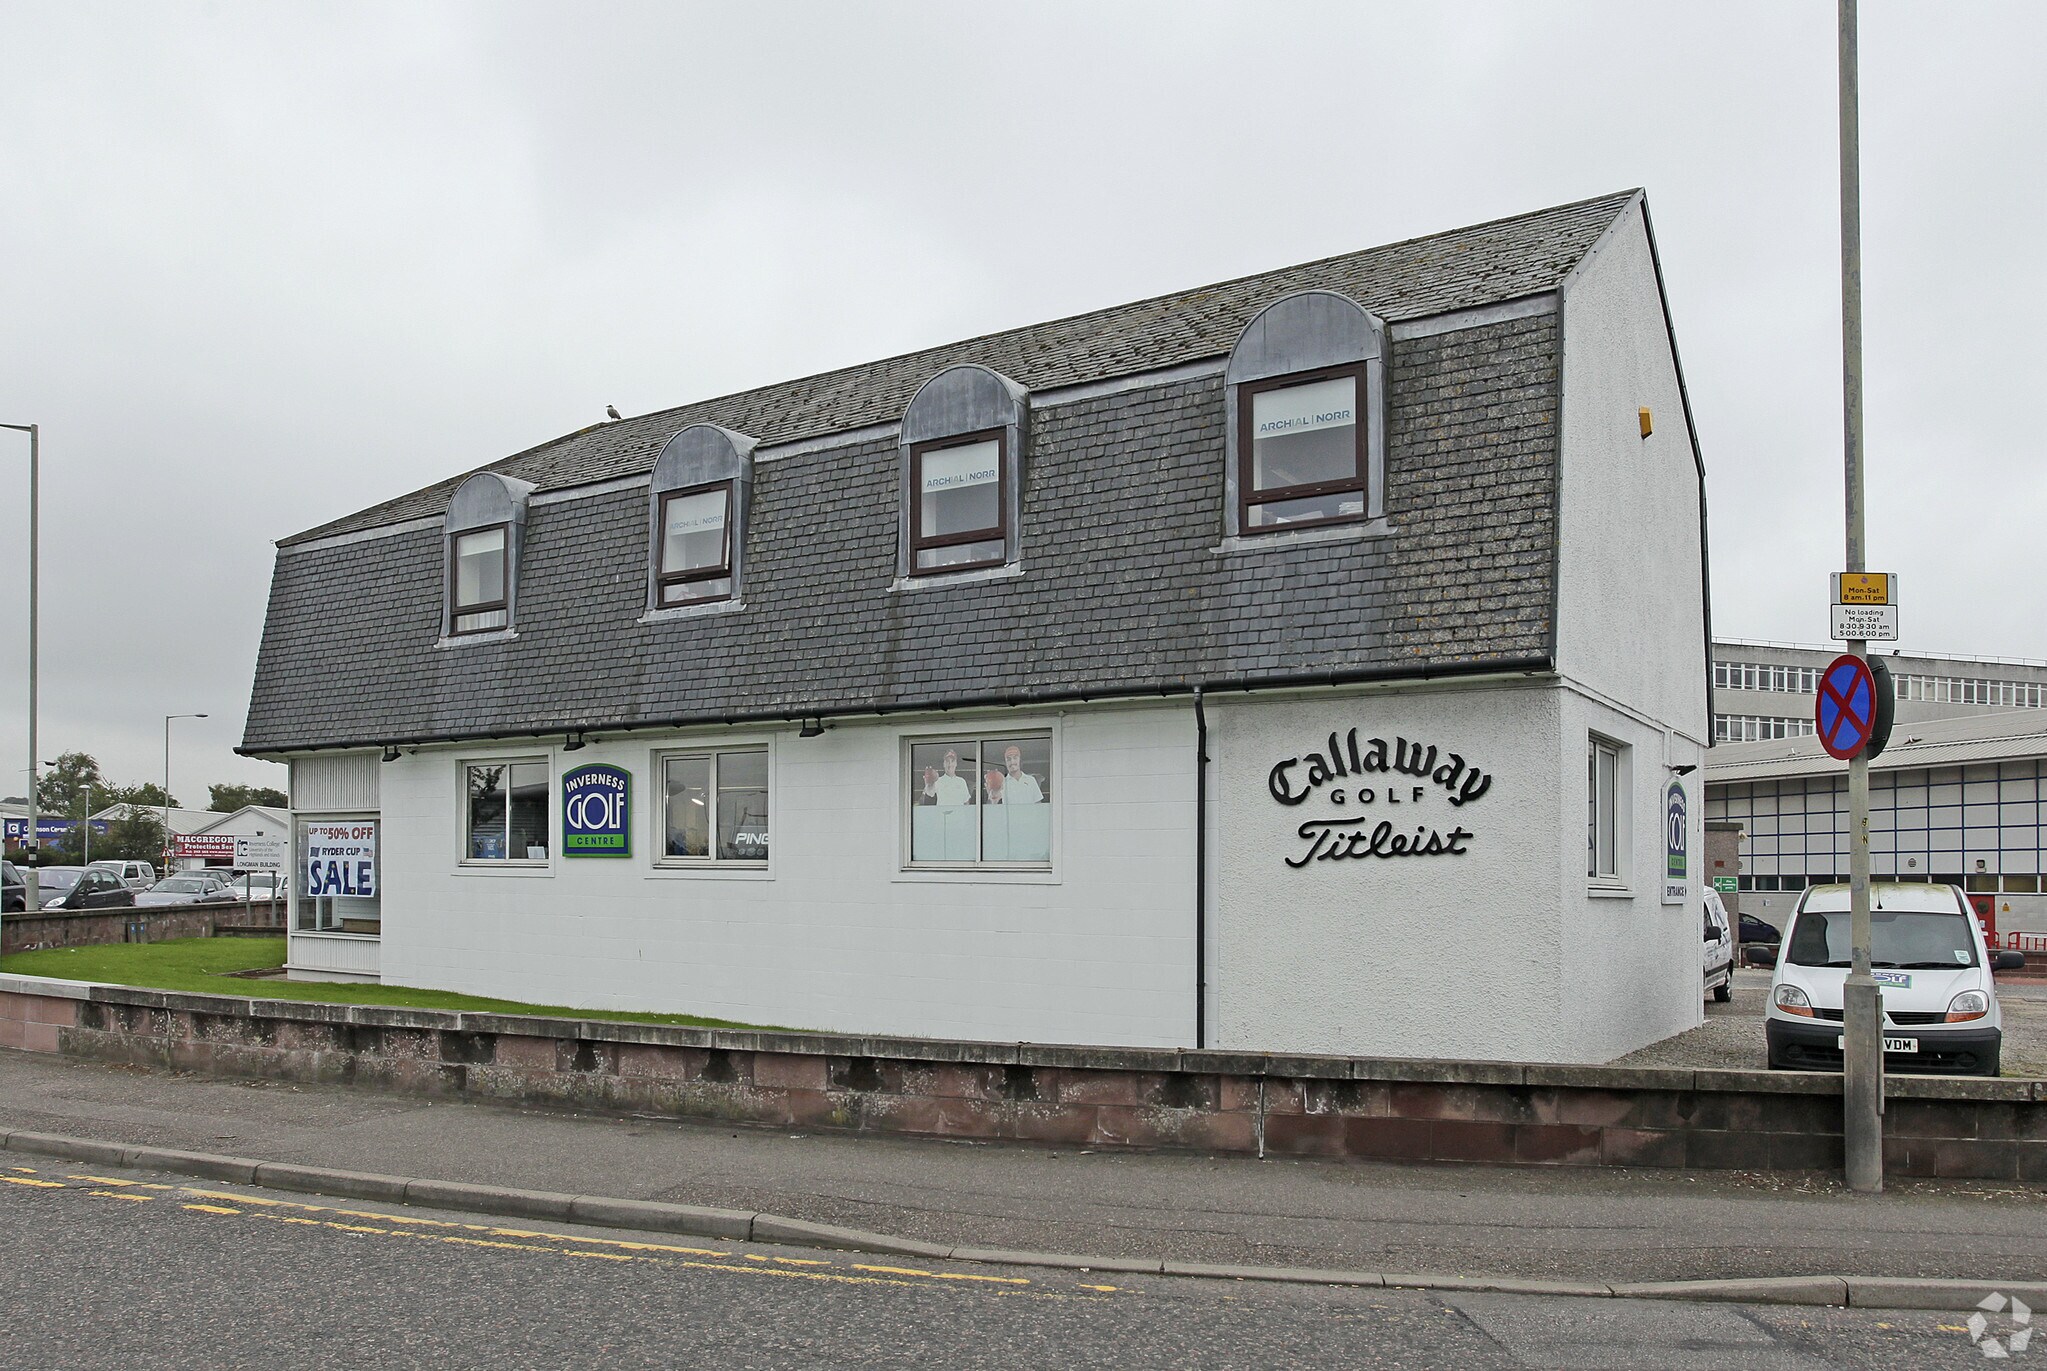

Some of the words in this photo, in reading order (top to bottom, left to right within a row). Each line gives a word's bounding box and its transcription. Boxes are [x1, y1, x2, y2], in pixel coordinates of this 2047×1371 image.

[1260, 416, 1309, 432] ARCHIAL
[1316, 410, 1351, 423] NORR
[969, 469, 996, 480] NORR
[1268, 727, 1492, 806] Callaway
[566, 773, 625, 793] INVERNESS
[1330, 786, 1424, 805] GOLF
[566, 792, 625, 830] GOLF
[309, 827, 319, 835] UP
[319, 827, 328, 835] TO
[328, 827, 350, 840] 50%
[351, 826, 374, 840] OFF
[576, 836, 615, 845] CENTRE
[1668, 812, 1685, 851] GOLF
[322, 847, 345, 856] RYDER
[345, 847, 361, 856] CUP
[1285, 816, 1474, 868] Titleist
[310, 860, 373, 896] SALE
[1666, 885, 1685, 897] ENTRANCE
[1884, 1039, 1912, 1051] VDM
